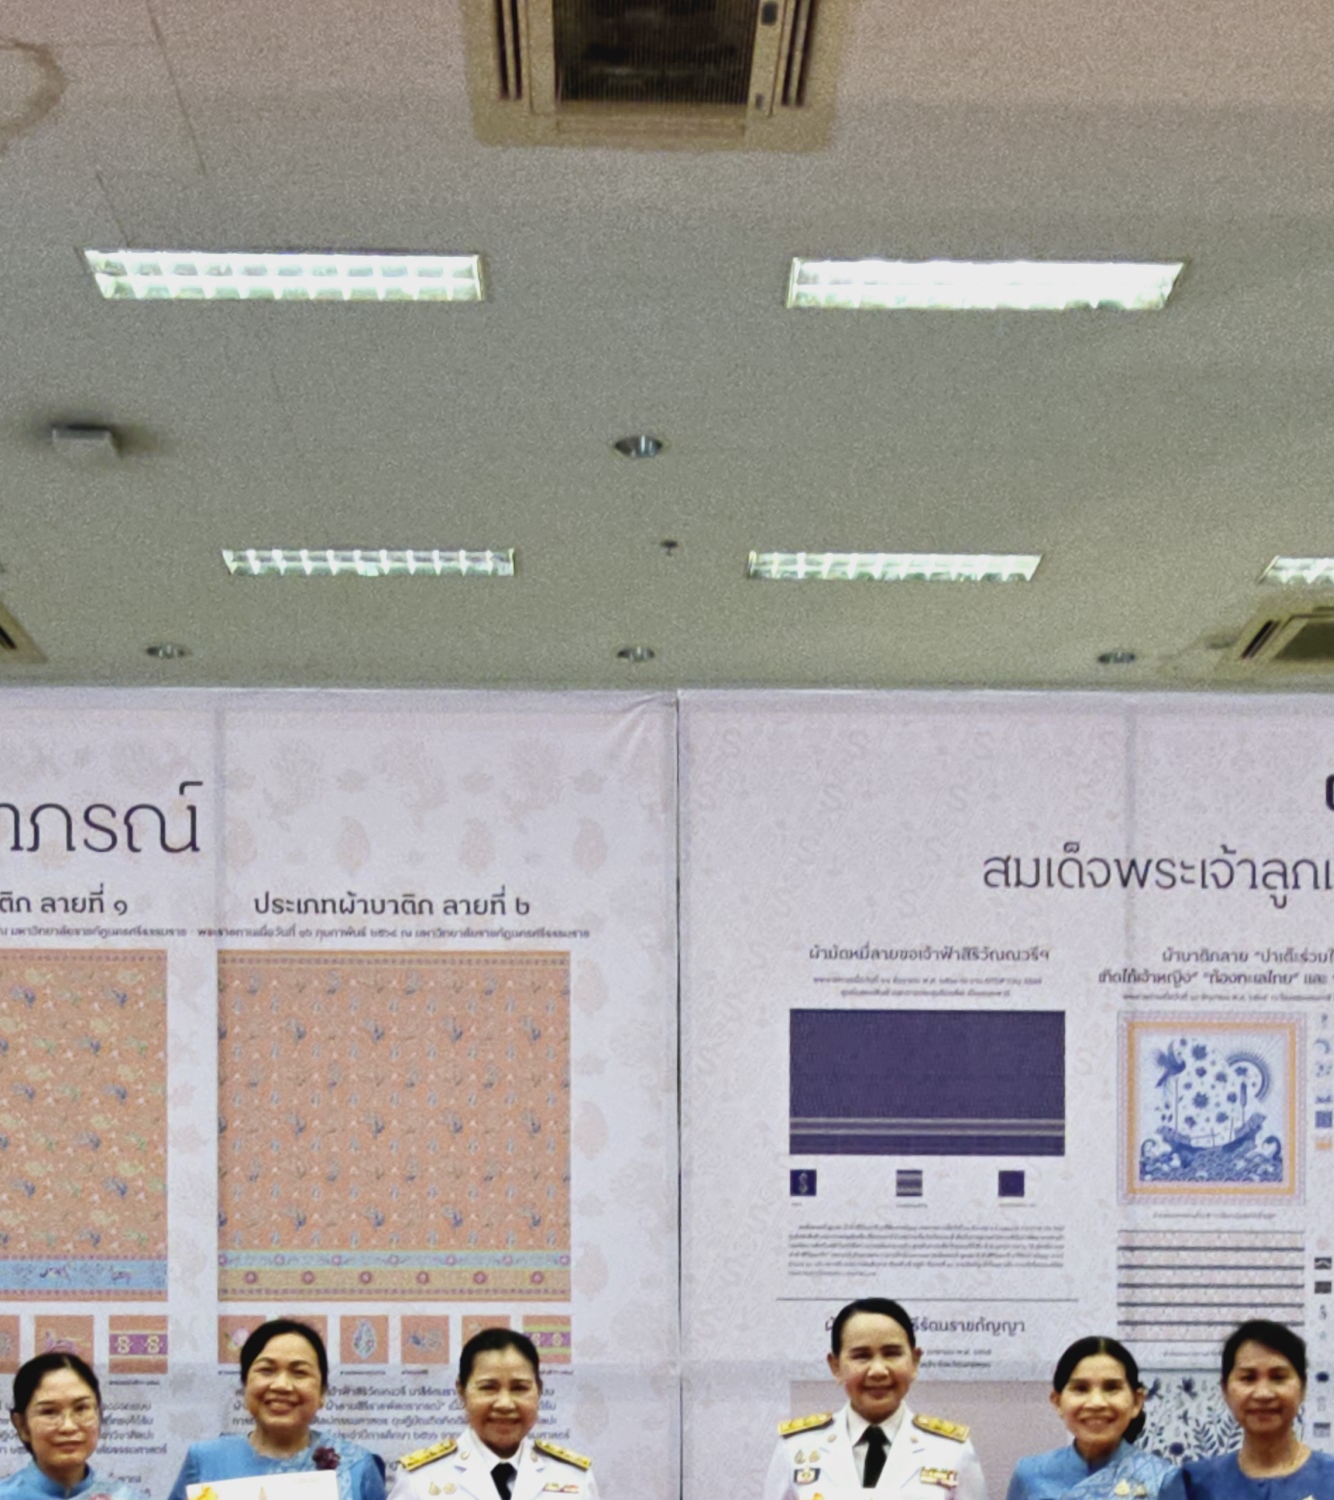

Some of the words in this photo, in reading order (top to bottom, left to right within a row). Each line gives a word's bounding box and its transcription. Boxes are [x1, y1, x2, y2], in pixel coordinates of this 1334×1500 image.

[41, 883, 104, 913] ลายที่
[114, 899, 129, 916] ๑
[254, 891, 433, 915] ประเภทผ้าบาติก
[443, 886, 505, 915] ลายที่
[515, 897, 531, 915] ๒
